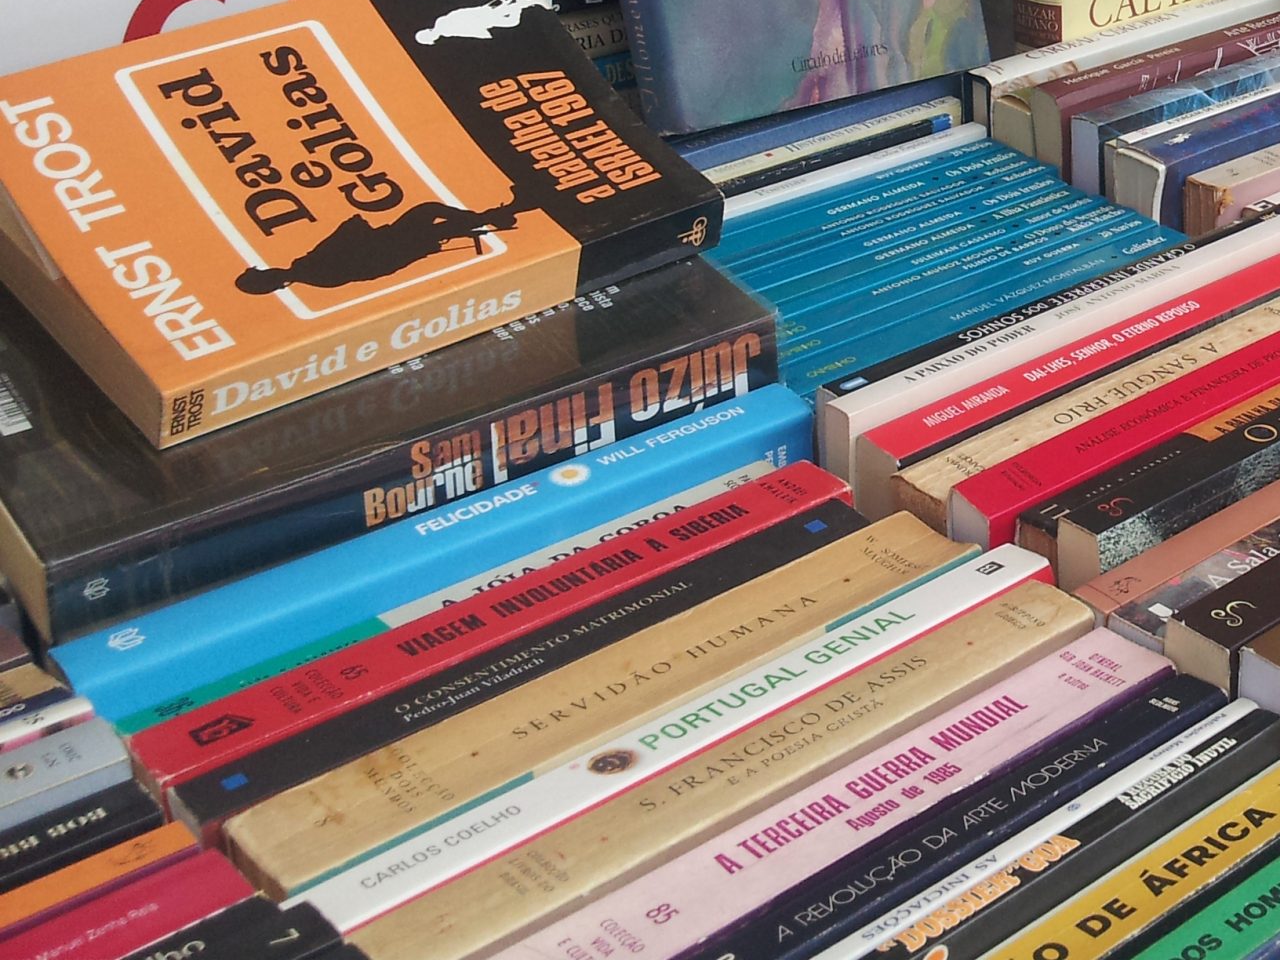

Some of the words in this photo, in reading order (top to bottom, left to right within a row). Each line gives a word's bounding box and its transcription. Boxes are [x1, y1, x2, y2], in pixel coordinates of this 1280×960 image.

[0, 96, 126, 233] TROST
[157, 67, 316, 236] David
[260, 44, 404, 213] Golias
[290, 159, 333, 189] e
[827, 193, 878, 216] GERMANO
[883, 180, 926, 201] ALMEIDA
[95, 240, 236, 360] ERNST
[211, 351, 347, 416] David
[356, 340, 377, 361] e
[391, 290, 523, 349] Golias
[1206, 343, 1218, 354] A
[597, 437, 642, 466] WILL
[645, 407, 745, 448] FERGUSON
[415, 484, 537, 535] FELICIDADE
[397, 615, 487, 656] VIAGEM
[491, 548, 643, 619] INVOLUNTÁRIA
[678, 504, 749, 539] SIBÉRIA
[511, 661, 672, 740] SERVIDÃO
[686, 596, 817, 660] HUMANA
[638, 664, 807, 751] PORTUGAL
[804, 611, 916, 665] GENIAL
[668, 711, 821, 796] FRANCISCO
[827, 690, 861, 713] DE
[858, 655, 928, 694] ASSIS
[715, 852, 739, 875] A
[736, 794, 850, 859] TERCEIRA
[845, 748, 935, 802] GUERRA
[931, 693, 1028, 753] MUNDIAL
[794, 848, 922, 927] REVOLUÇÃO
[927, 826, 958, 850] DA
[962, 796, 1006, 830] ARTE
[1009, 737, 1108, 800] MODERNA
[1077, 899, 1136, 937] DE
[1149, 806, 1278, 896] ÁFRICA
